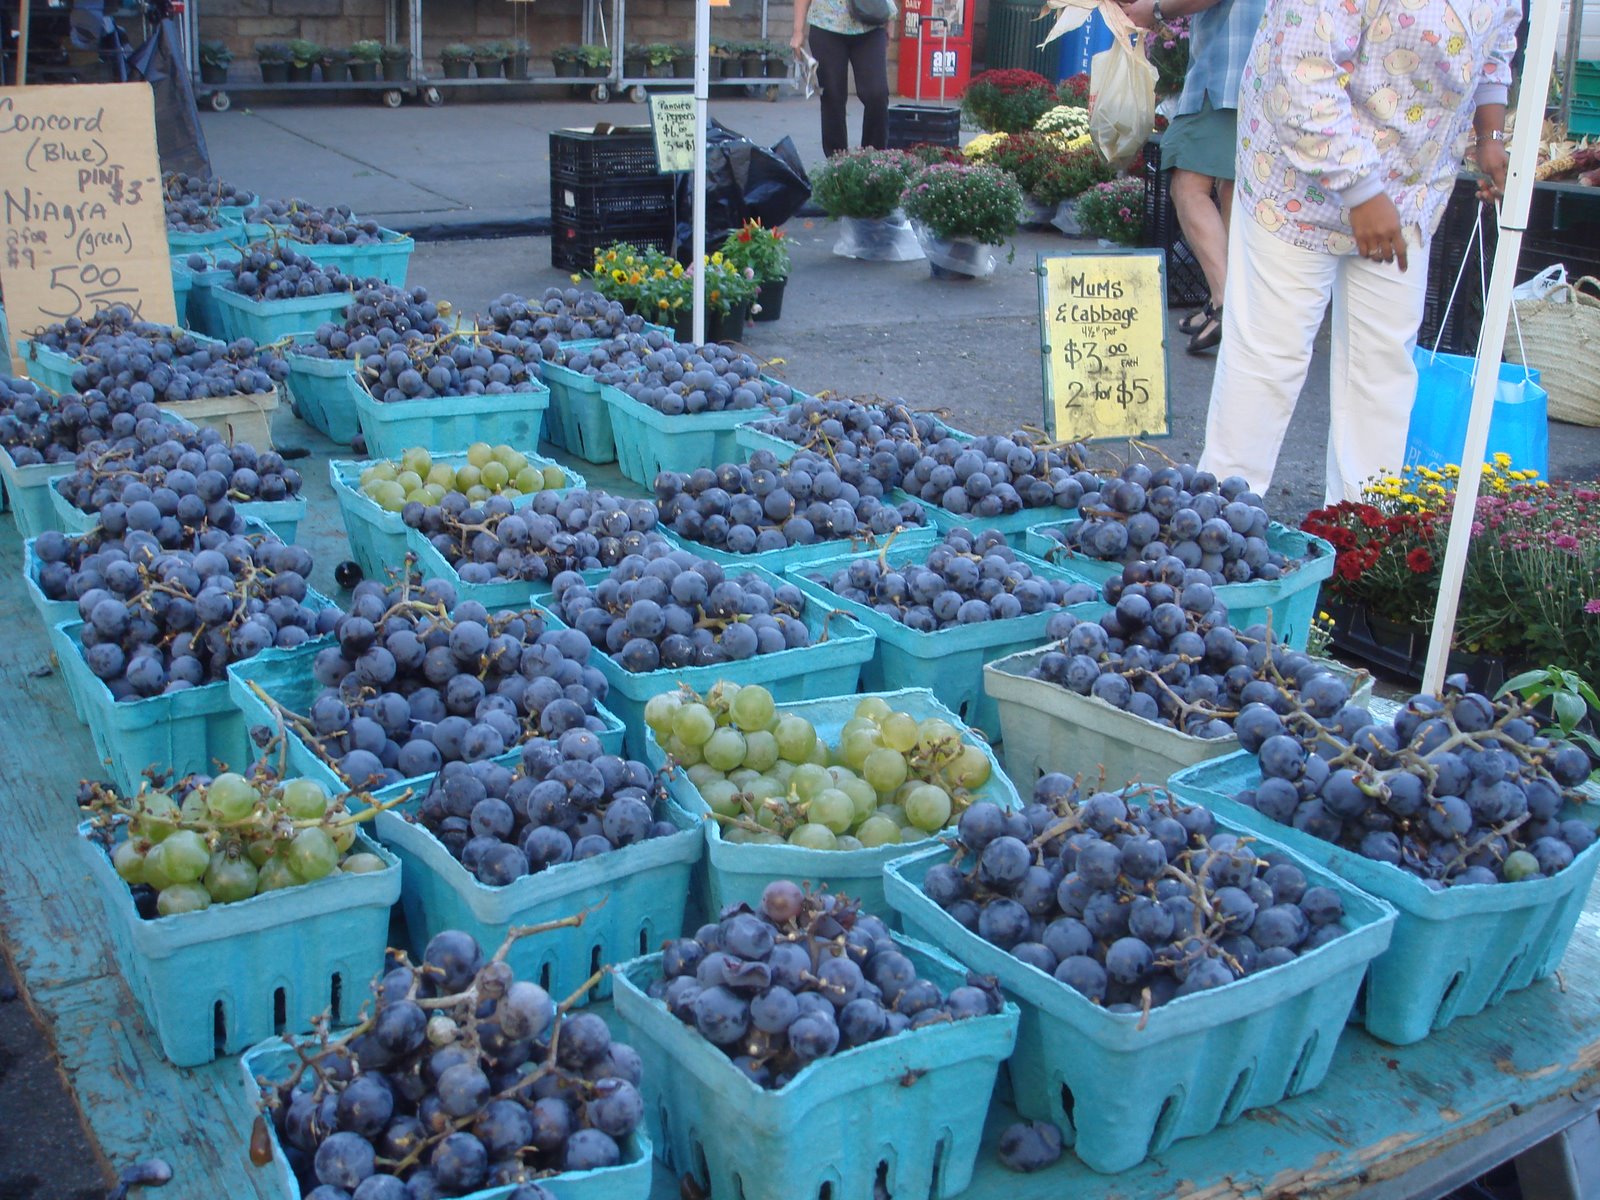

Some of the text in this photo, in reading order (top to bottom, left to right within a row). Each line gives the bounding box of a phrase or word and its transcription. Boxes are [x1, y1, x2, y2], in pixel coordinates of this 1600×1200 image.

[933, 51, 956, 68] am
[0, 97, 104, 133] Concord
[25, 137, 109, 172] (Blue)
[78, 164, 124, 193] PINT
[77, 222, 133, 261] (green)
[1071, 304, 1139, 329] Cabbage
[1065, 378, 1149, 410] 2 for $5
